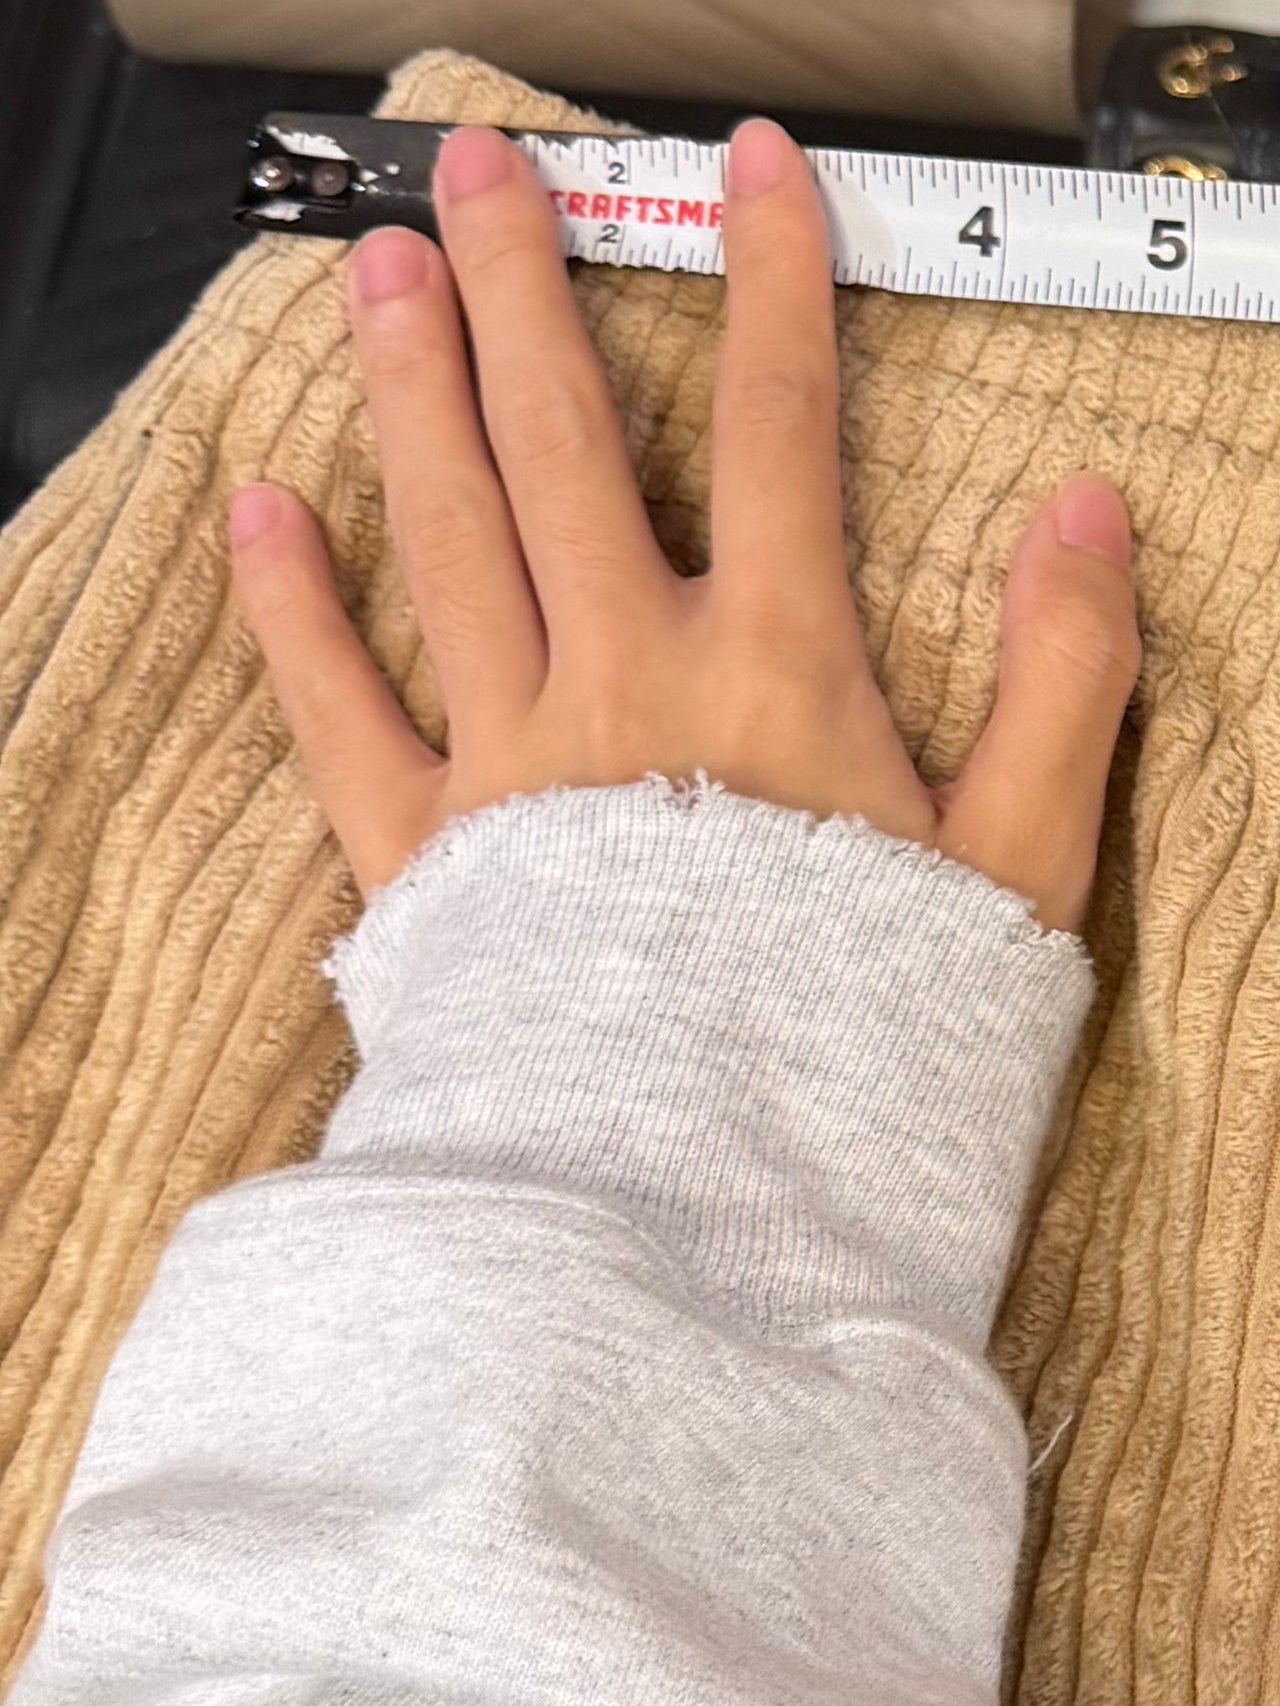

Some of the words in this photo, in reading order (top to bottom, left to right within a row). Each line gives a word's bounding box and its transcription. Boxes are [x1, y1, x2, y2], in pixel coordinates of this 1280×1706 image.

[608, 161, 626, 185] 2
[549, 190, 725, 228] CRAFTSMA
[600, 223, 620, 243] 2
[958, 205, 1001, 258] 4
[1147, 220, 1188, 271] 5
